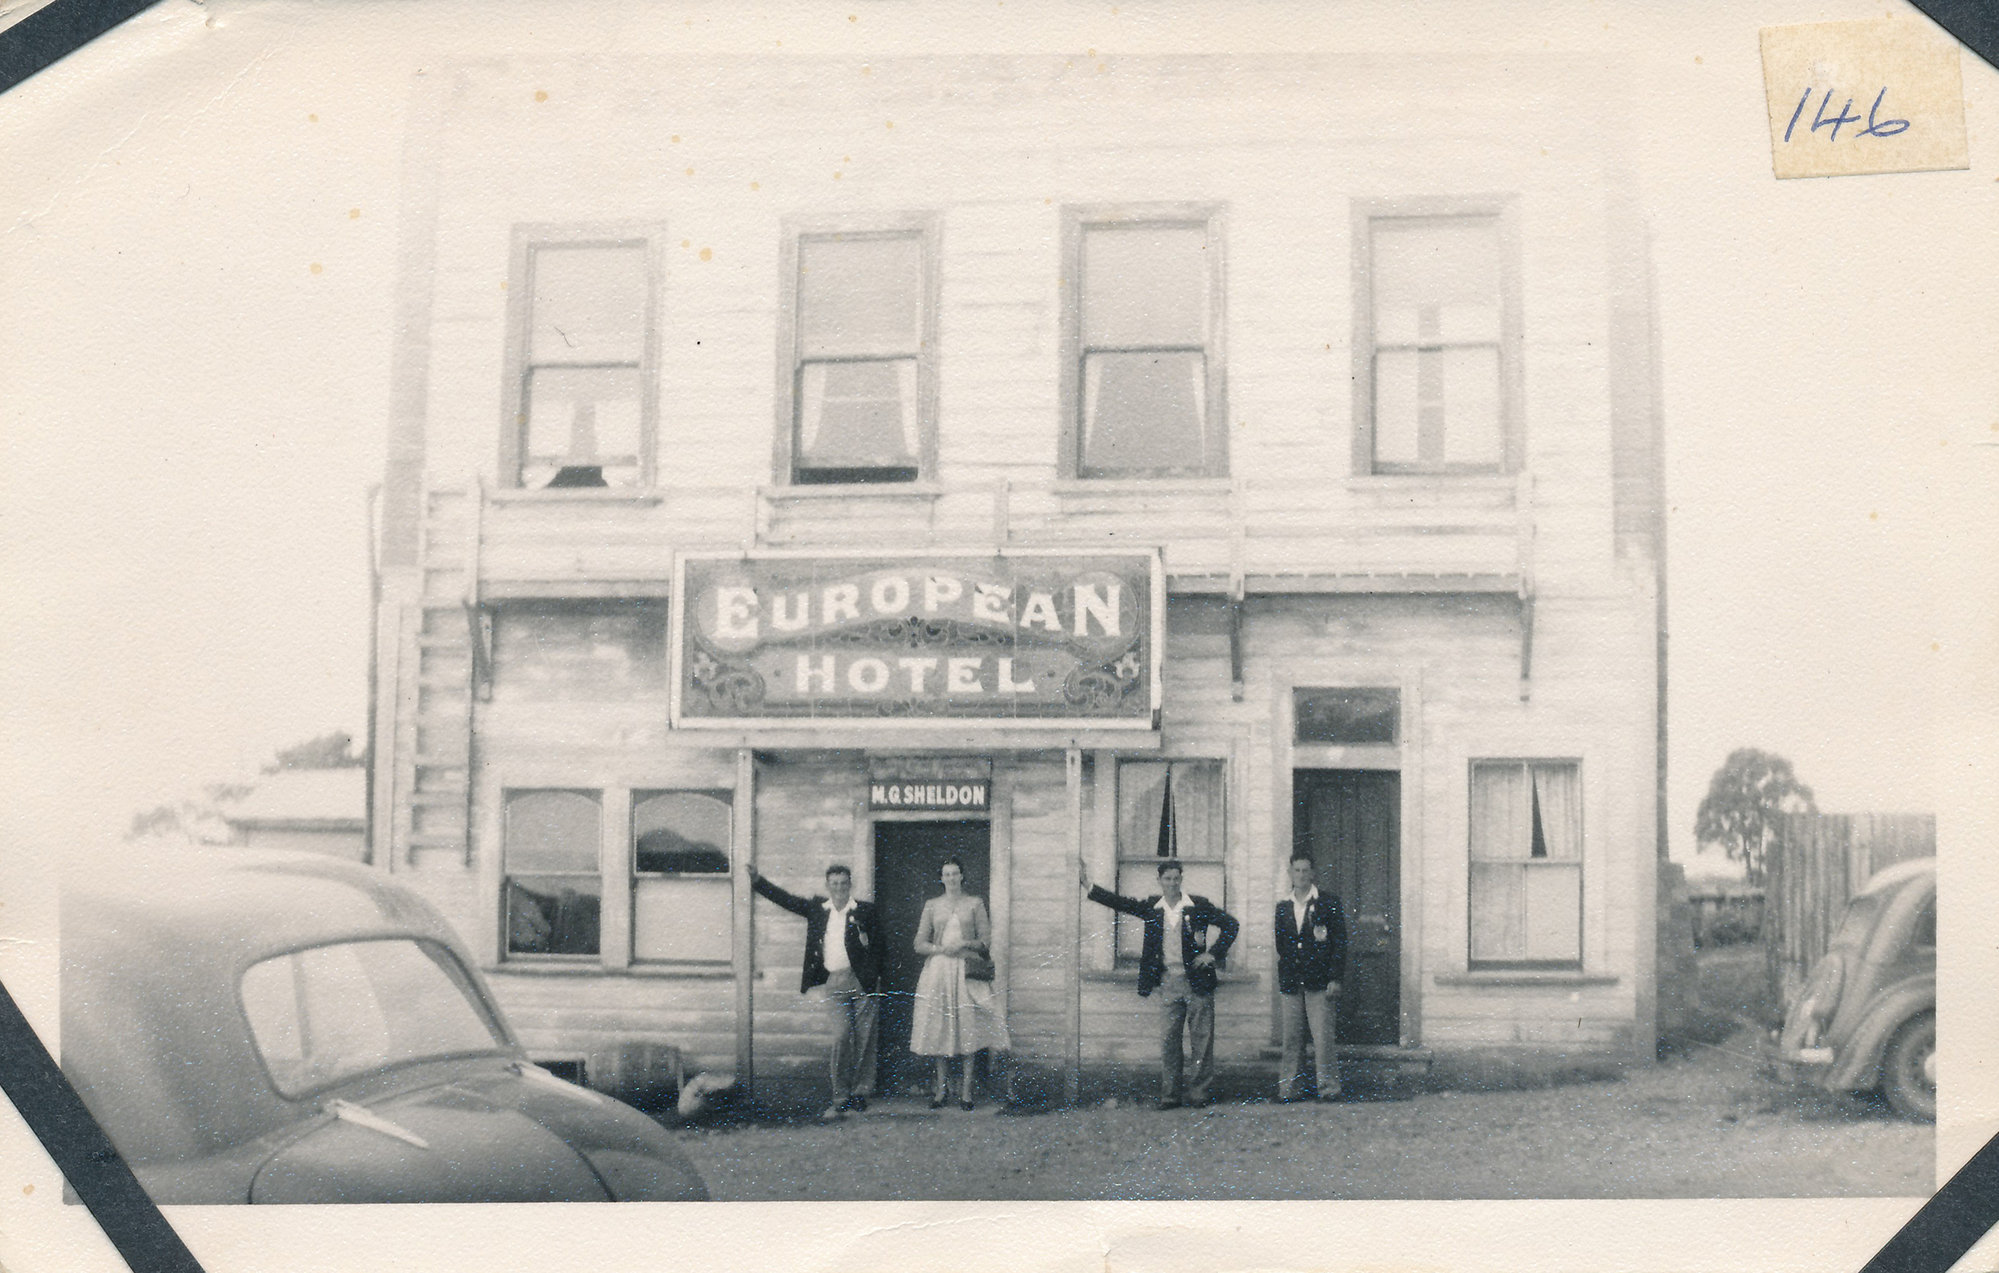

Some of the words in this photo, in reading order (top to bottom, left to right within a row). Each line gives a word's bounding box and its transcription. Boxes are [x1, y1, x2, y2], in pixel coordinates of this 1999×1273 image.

[1784, 86, 1910, 142] 146
[712, 574, 1121, 639] EUROPEAN
[796, 654, 1035, 693] HOTEL
[903, 785, 985, 805] SHELDON
